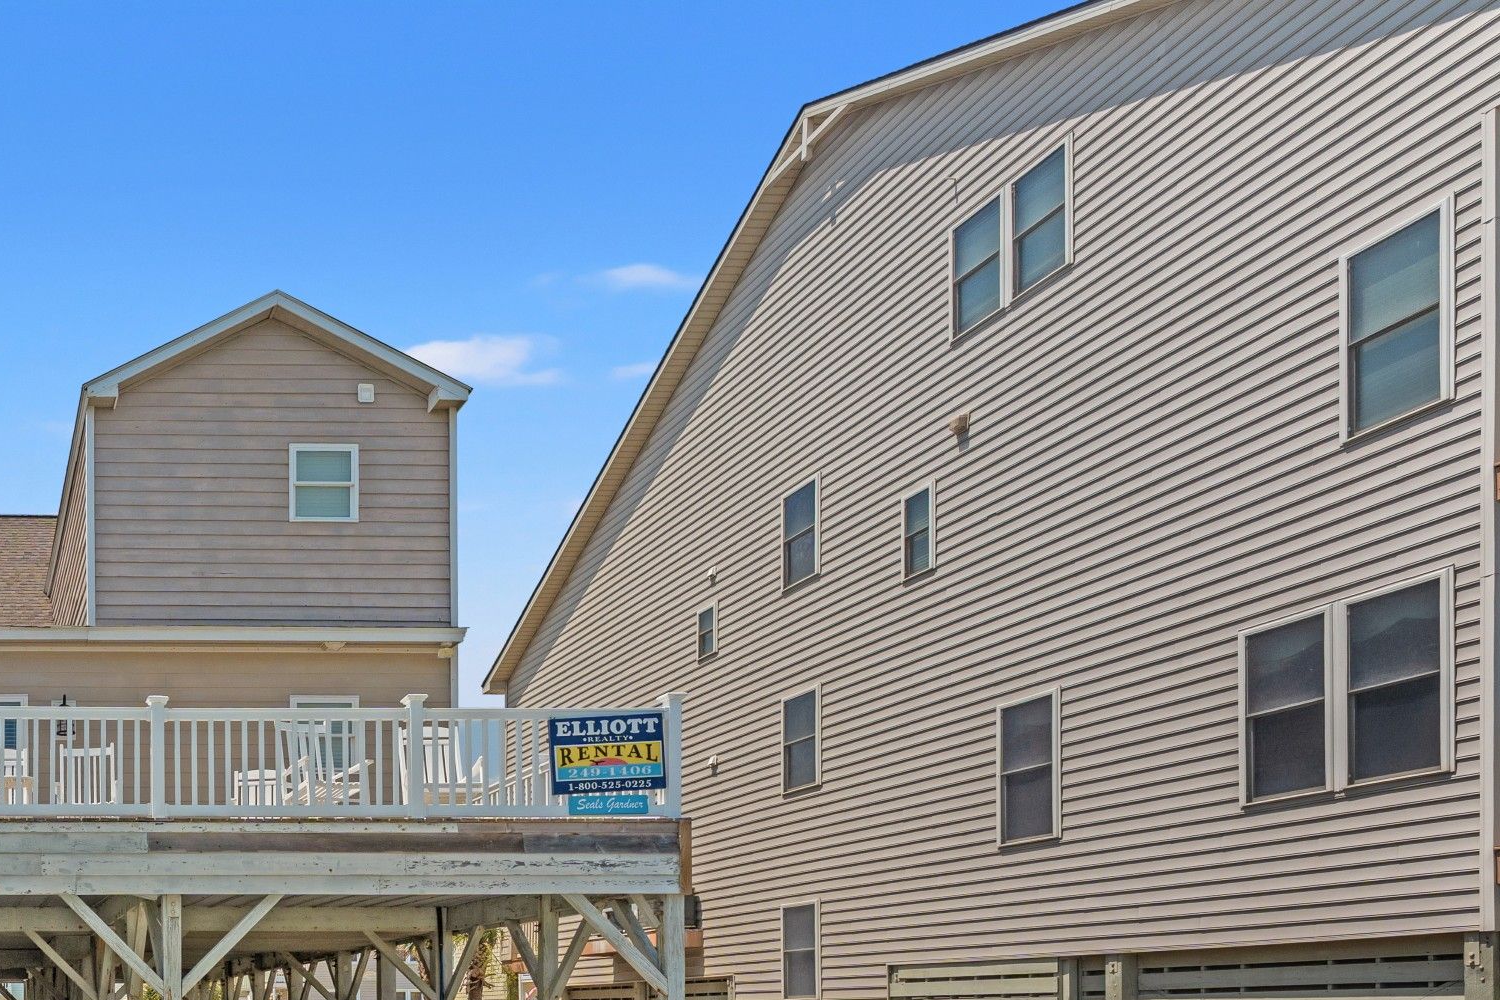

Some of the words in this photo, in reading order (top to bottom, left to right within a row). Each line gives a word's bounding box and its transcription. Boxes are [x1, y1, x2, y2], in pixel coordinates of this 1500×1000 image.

[555, 718, 659, 737] ELLIOTT
[587, 735, 629, 743] REALTY
[559, 743, 659, 767] RENTAL
[568, 779, 652, 791] 1-800-525-0225
